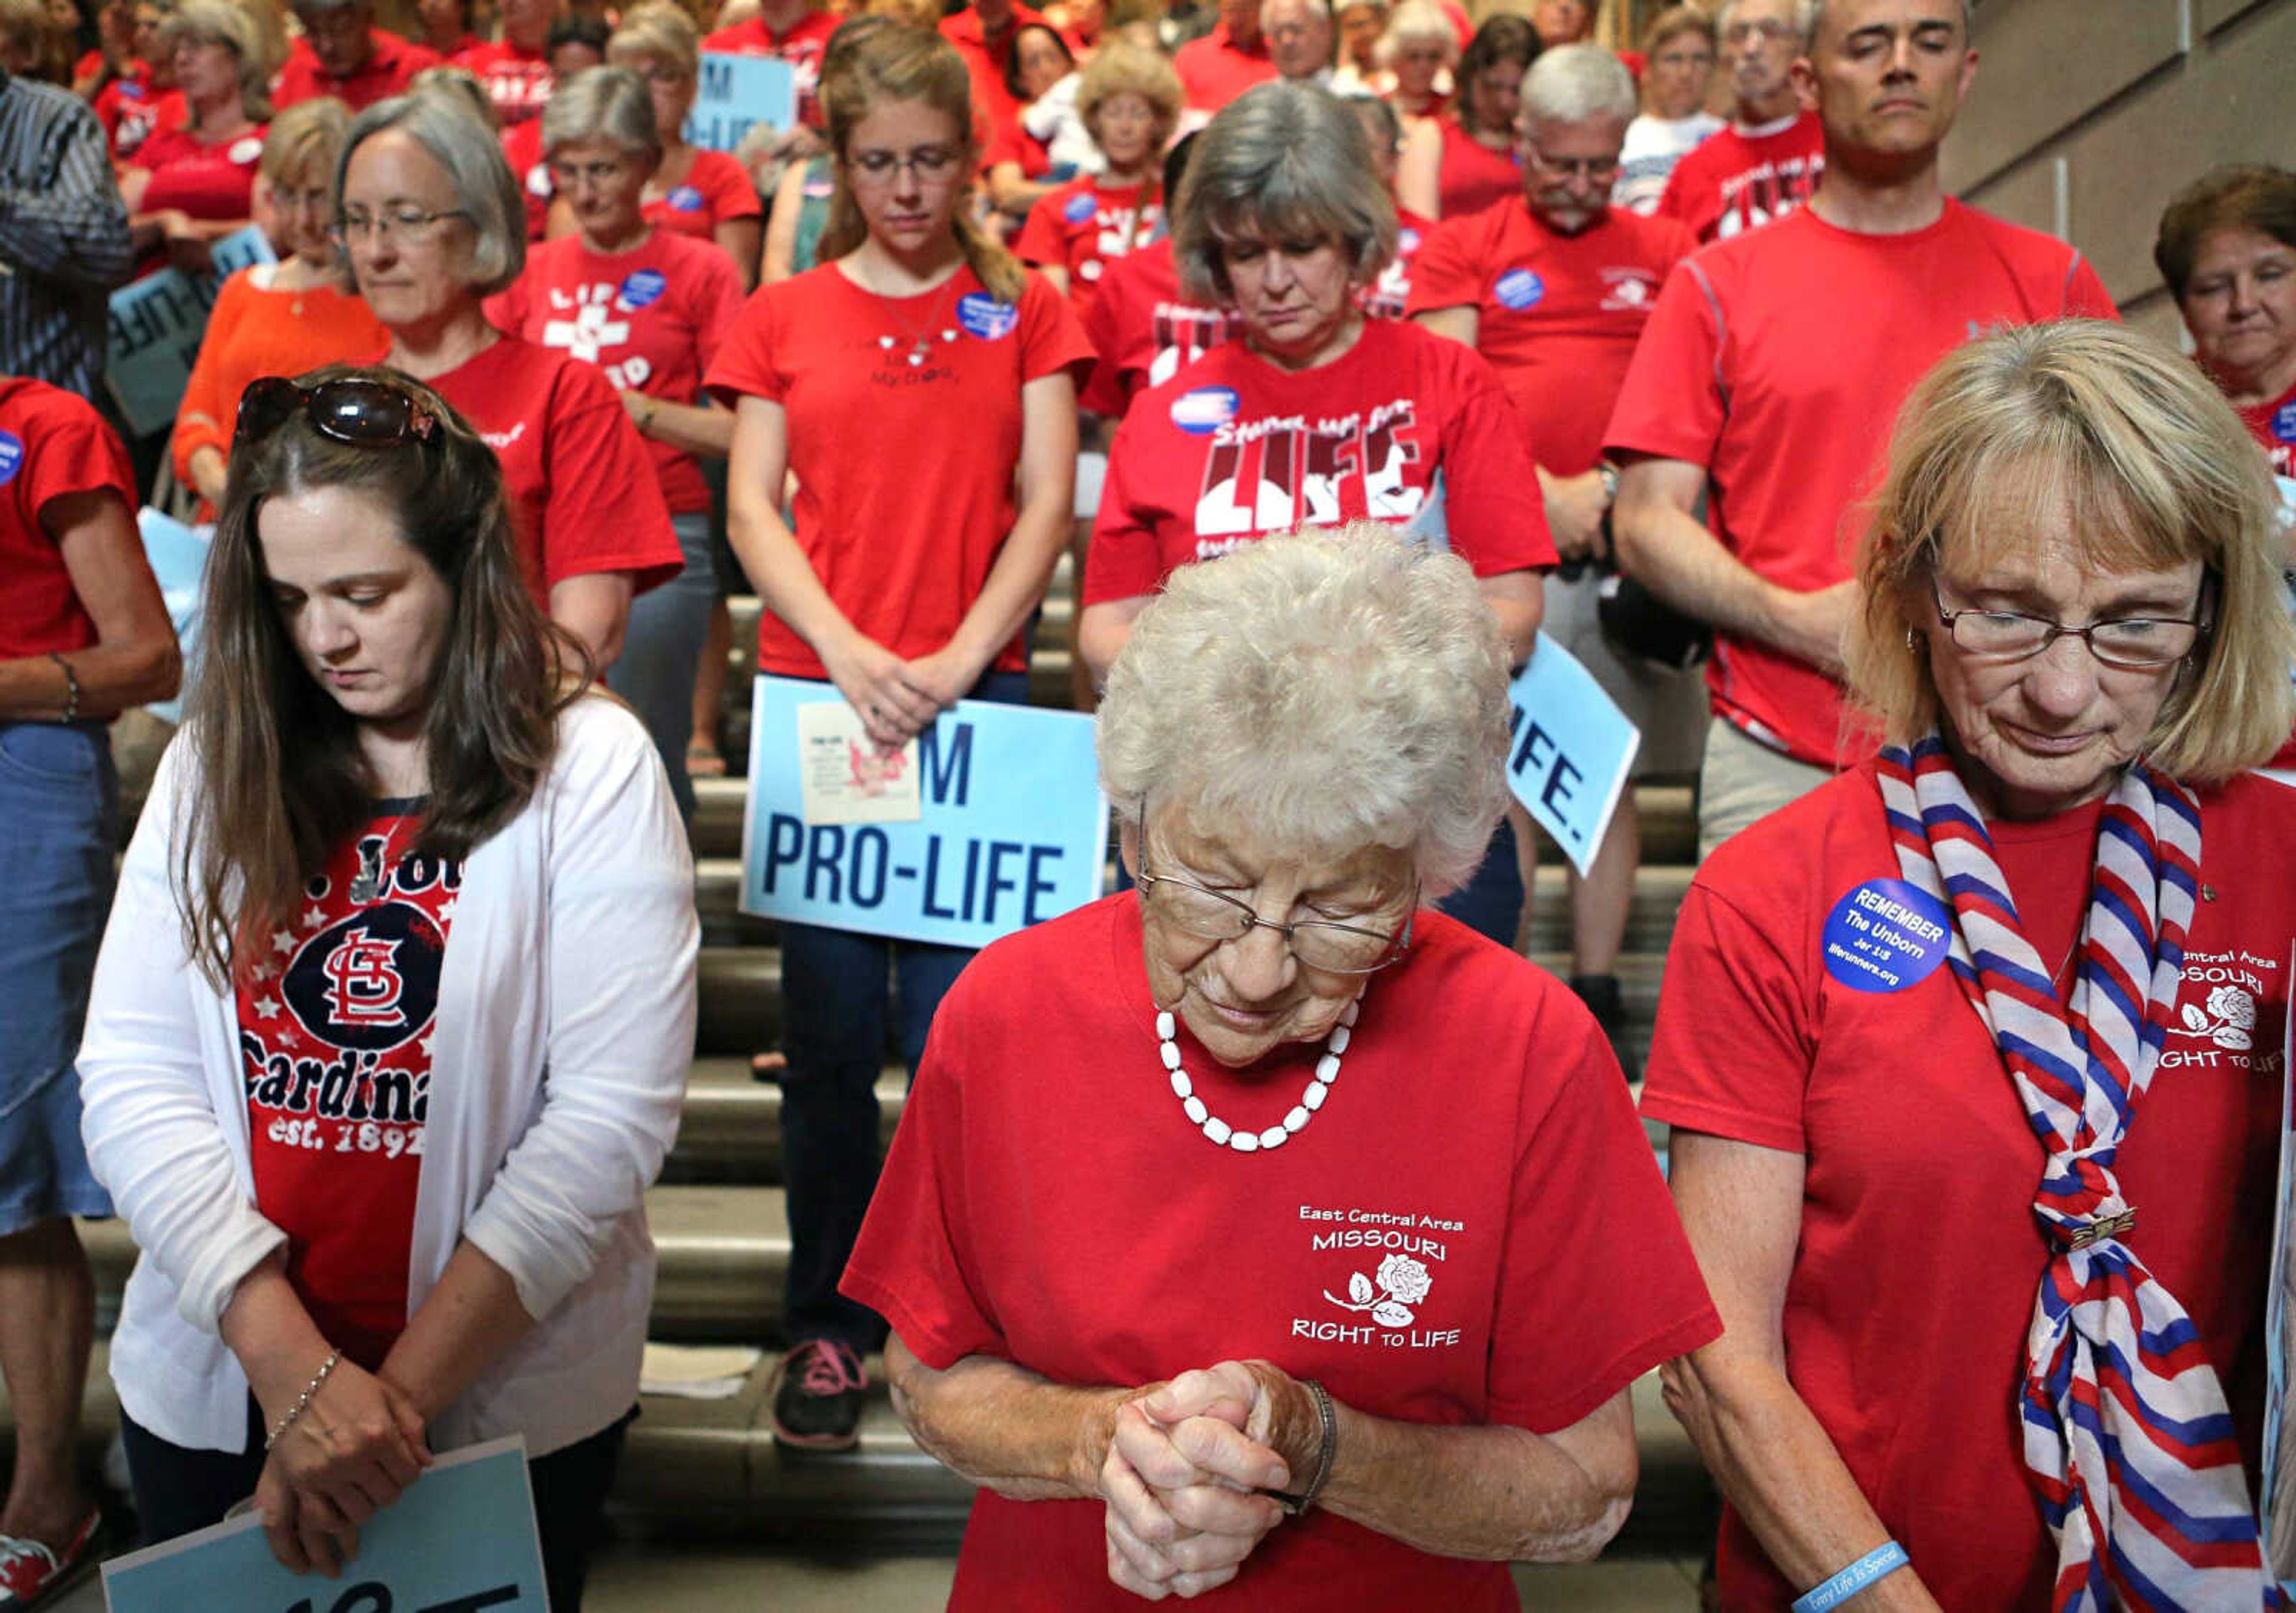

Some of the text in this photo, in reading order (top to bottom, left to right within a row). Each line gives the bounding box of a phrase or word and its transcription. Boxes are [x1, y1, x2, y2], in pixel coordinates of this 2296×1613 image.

[1213, 399, 1414, 446] Stand up for
[1195, 413, 1424, 536] LIFE
[763, 811, 1064, 927] PRO-LIFE
[1855, 888, 1944, 943] REMEMBER
[1845, 909, 1925, 960] The Unborn
[1854, 938, 1873, 951] Jer
[2240, 950, 2276, 968] Area
[2160, 1050, 2222, 1068] GHT
[2252, 1048, 2285, 1073] LIF
[268, 1116, 425, 1159] est. 1892
[1299, 1205, 1464, 1231] East Central Area
[1312, 1230, 1446, 1261] MISSOURI
[1292, 1318, 1375, 1344] RIGHT
[1411, 1329, 1461, 1348] LIFE
[1832, 1574, 1853, 1595] Life
